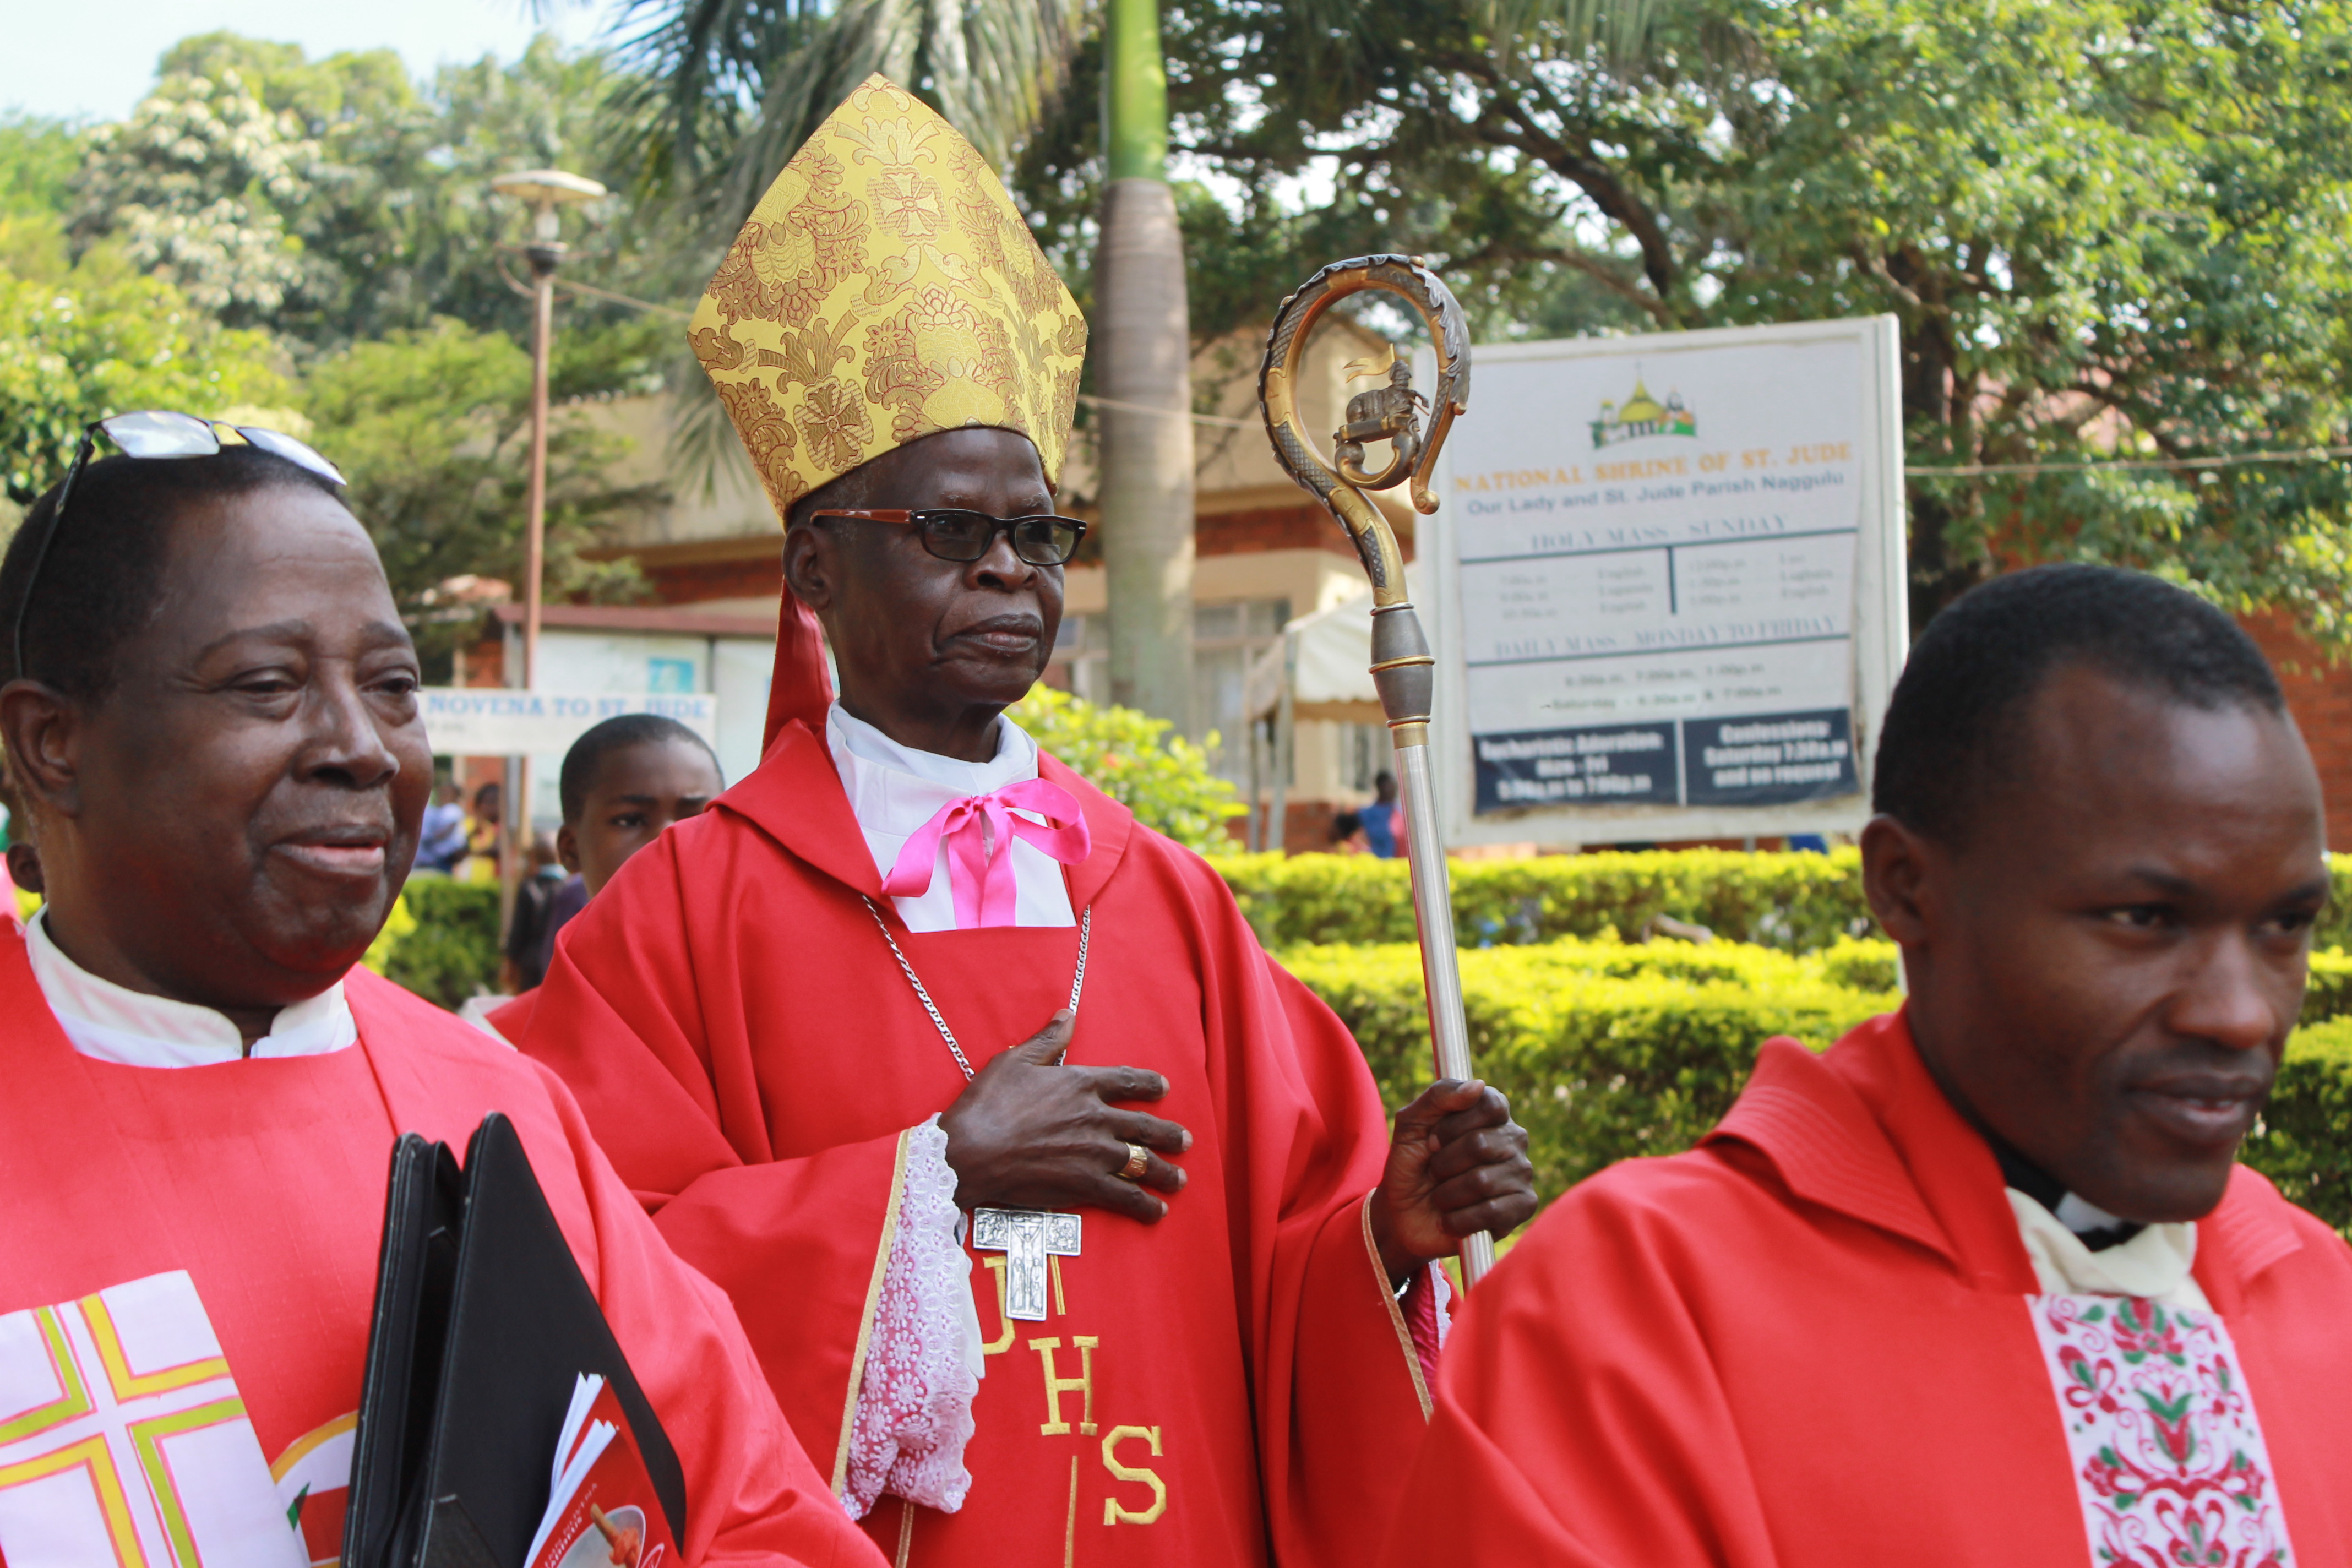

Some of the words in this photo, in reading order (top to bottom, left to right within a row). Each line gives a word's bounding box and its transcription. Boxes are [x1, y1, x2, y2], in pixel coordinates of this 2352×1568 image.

[1455, 466, 1583, 492] NATIONAL
[1595, 458, 1688, 482] SHRINE
[1698, 451, 1729, 472] OF
[1741, 448, 1777, 469] ST.
[1787, 442, 1853, 466] JUDE
[1467, 498, 1503, 516] Our
[1509, 495, 1556, 513] Lady
[1562, 491, 1598, 508] and
[1636, 484, 1685, 502] Jude
[1692, 477, 1756, 497] Parish
[1762, 470, 1844, 491] Naggulu
[1532, 527, 1596, 550] HOLY
[1607, 522, 1669, 544] MASS
[1687, 513, 1788, 535] SUNDAY
[1494, 637, 1559, 657] DAILY
[1565, 635, 1617, 653] MASS
[1634, 624, 1722, 647] MONDAY
[1759, 615, 1837, 637] FRIDAY
[428, 694, 545, 716] NOVENA
[552, 695, 591, 717] TO
[645, 698, 709, 718] JUDE
